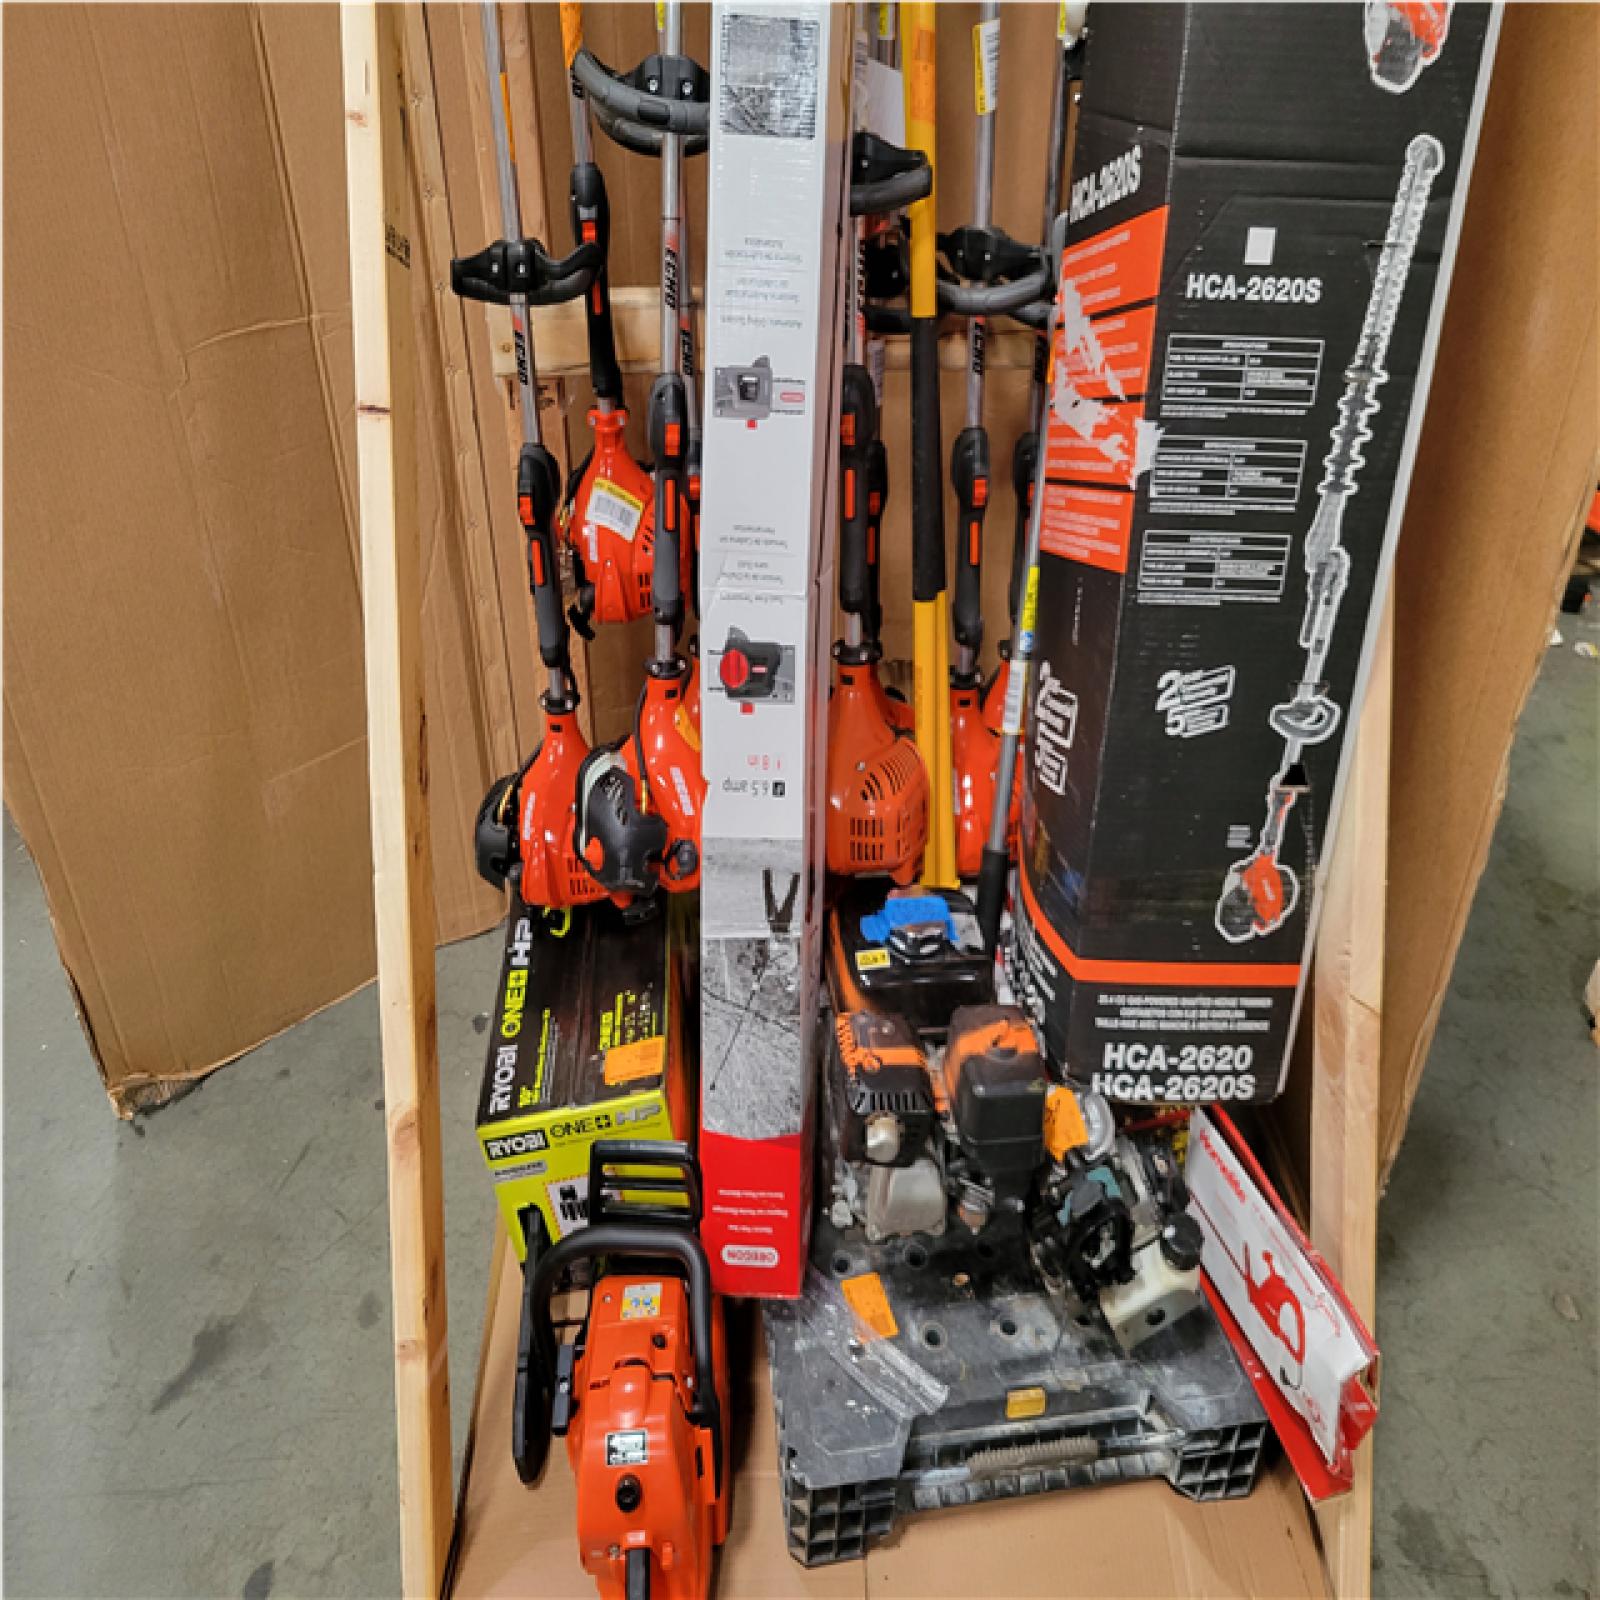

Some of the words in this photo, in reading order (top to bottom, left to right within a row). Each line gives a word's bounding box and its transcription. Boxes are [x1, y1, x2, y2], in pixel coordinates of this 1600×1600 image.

[664, 248, 677, 309] ECHO
[1186, 274, 1322, 303] HCA-2620S
[514, 329, 529, 386] ECHO
[681, 328, 693, 376] ECHO
[974, 323, 985, 375] ECHO
[722, 776, 748, 793] amp
[489, 1045, 518, 1115] RYOBI
[510, 917, 532, 966] HP
[1103, 1042, 1253, 1071] HCA-2620
[1091, 1071, 1256, 1101] HCA-2620S
[488, 1132, 546, 1157] RYOBI
[726, 1249, 776, 1263] OREGON
